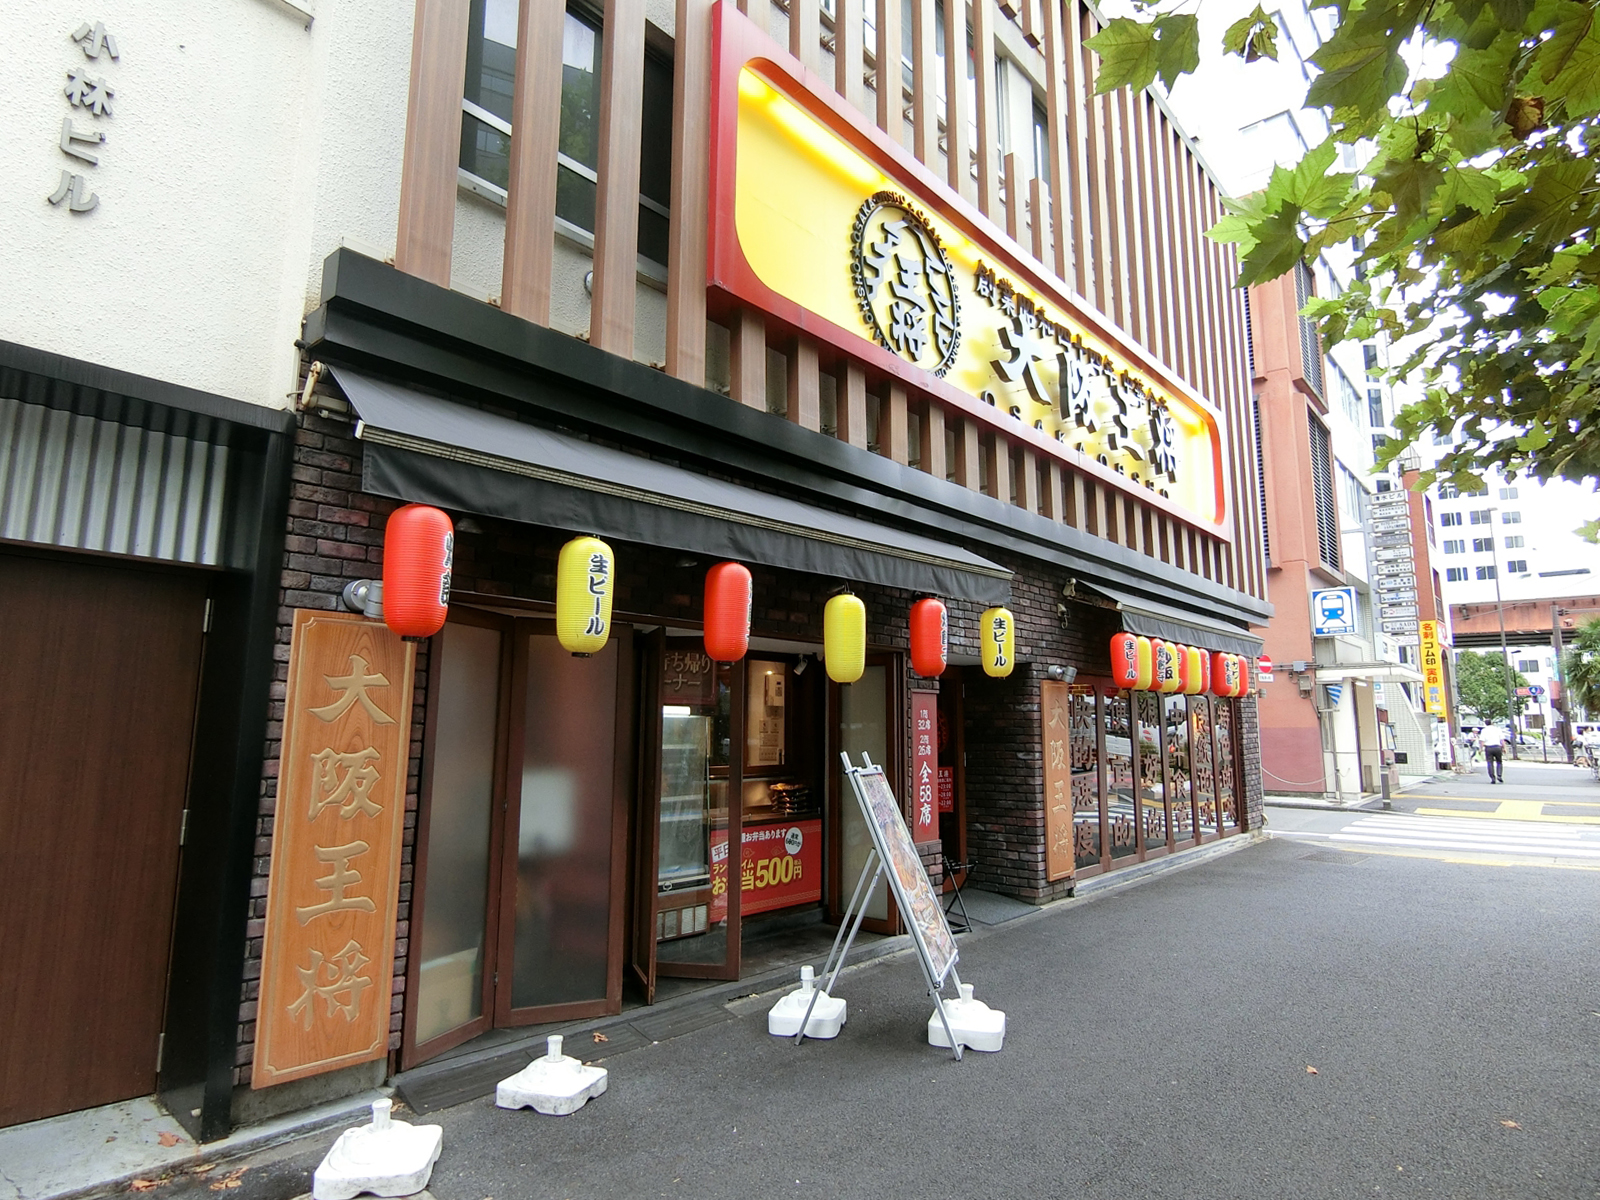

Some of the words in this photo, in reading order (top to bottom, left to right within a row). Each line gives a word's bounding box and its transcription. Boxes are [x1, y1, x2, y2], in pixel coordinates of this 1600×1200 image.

[47, 20, 121, 214] 小林ビル
[585, 553, 609, 636] 生ビール
[1423, 623, 1434, 640] 名刺
[993, 617, 1007, 667] 生ビール
[1124, 641, 1137, 680] 生ビール
[919, 761, 932, 827] 全58席
[1048, 698, 1070, 860] 大阪王将
[1108, 698, 1133, 848] 便宜的
[286, 654, 399, 1032] 大阪王将
